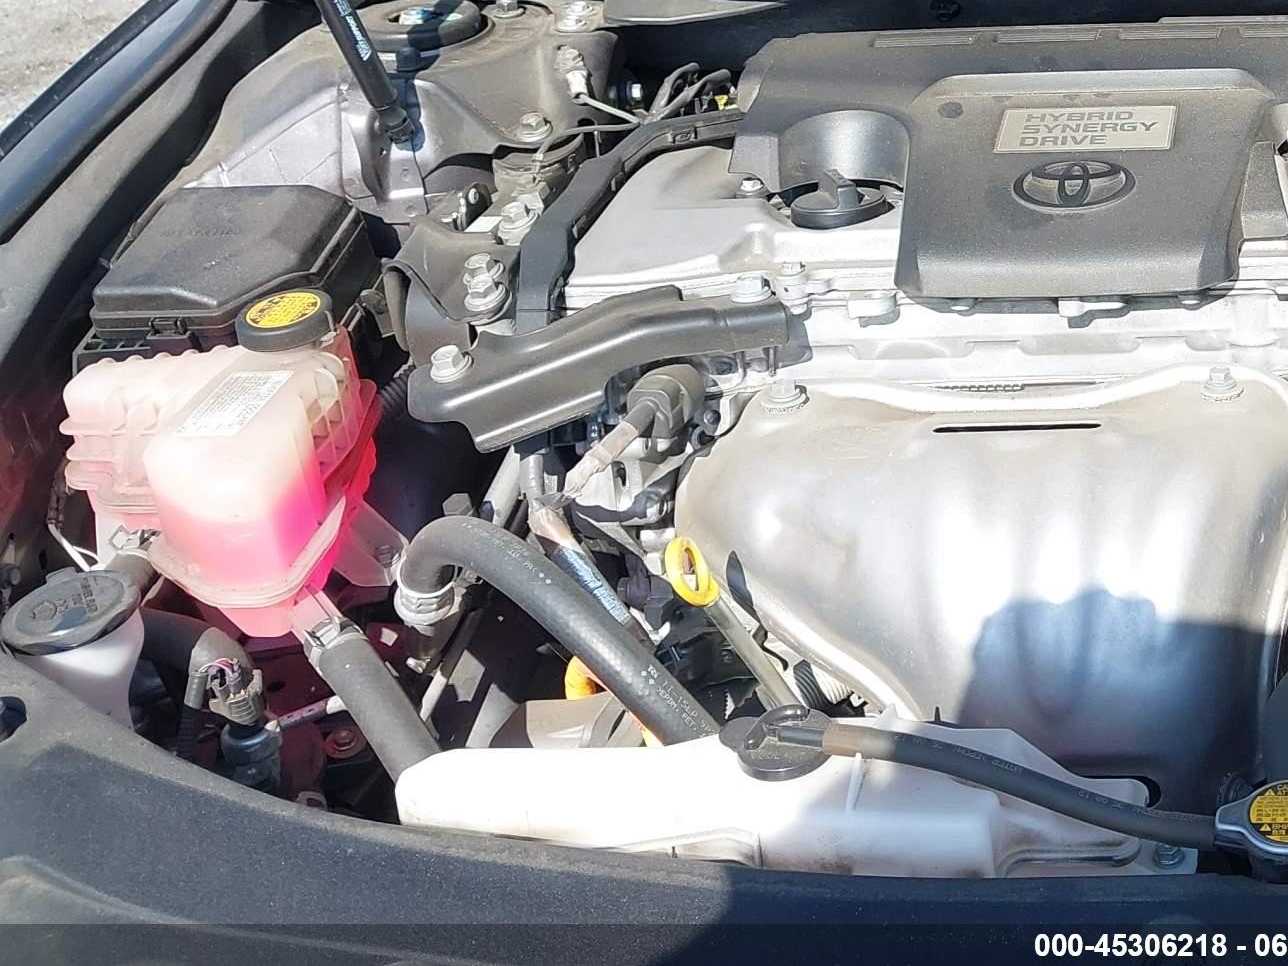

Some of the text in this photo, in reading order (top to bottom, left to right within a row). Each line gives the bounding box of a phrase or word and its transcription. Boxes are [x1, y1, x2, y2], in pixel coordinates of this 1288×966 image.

[1026, 111, 1134, 122] HYBRID
[1022, 121, 1159, 134] SYNERGY
[1019, 135, 1106, 146] DRIVE
